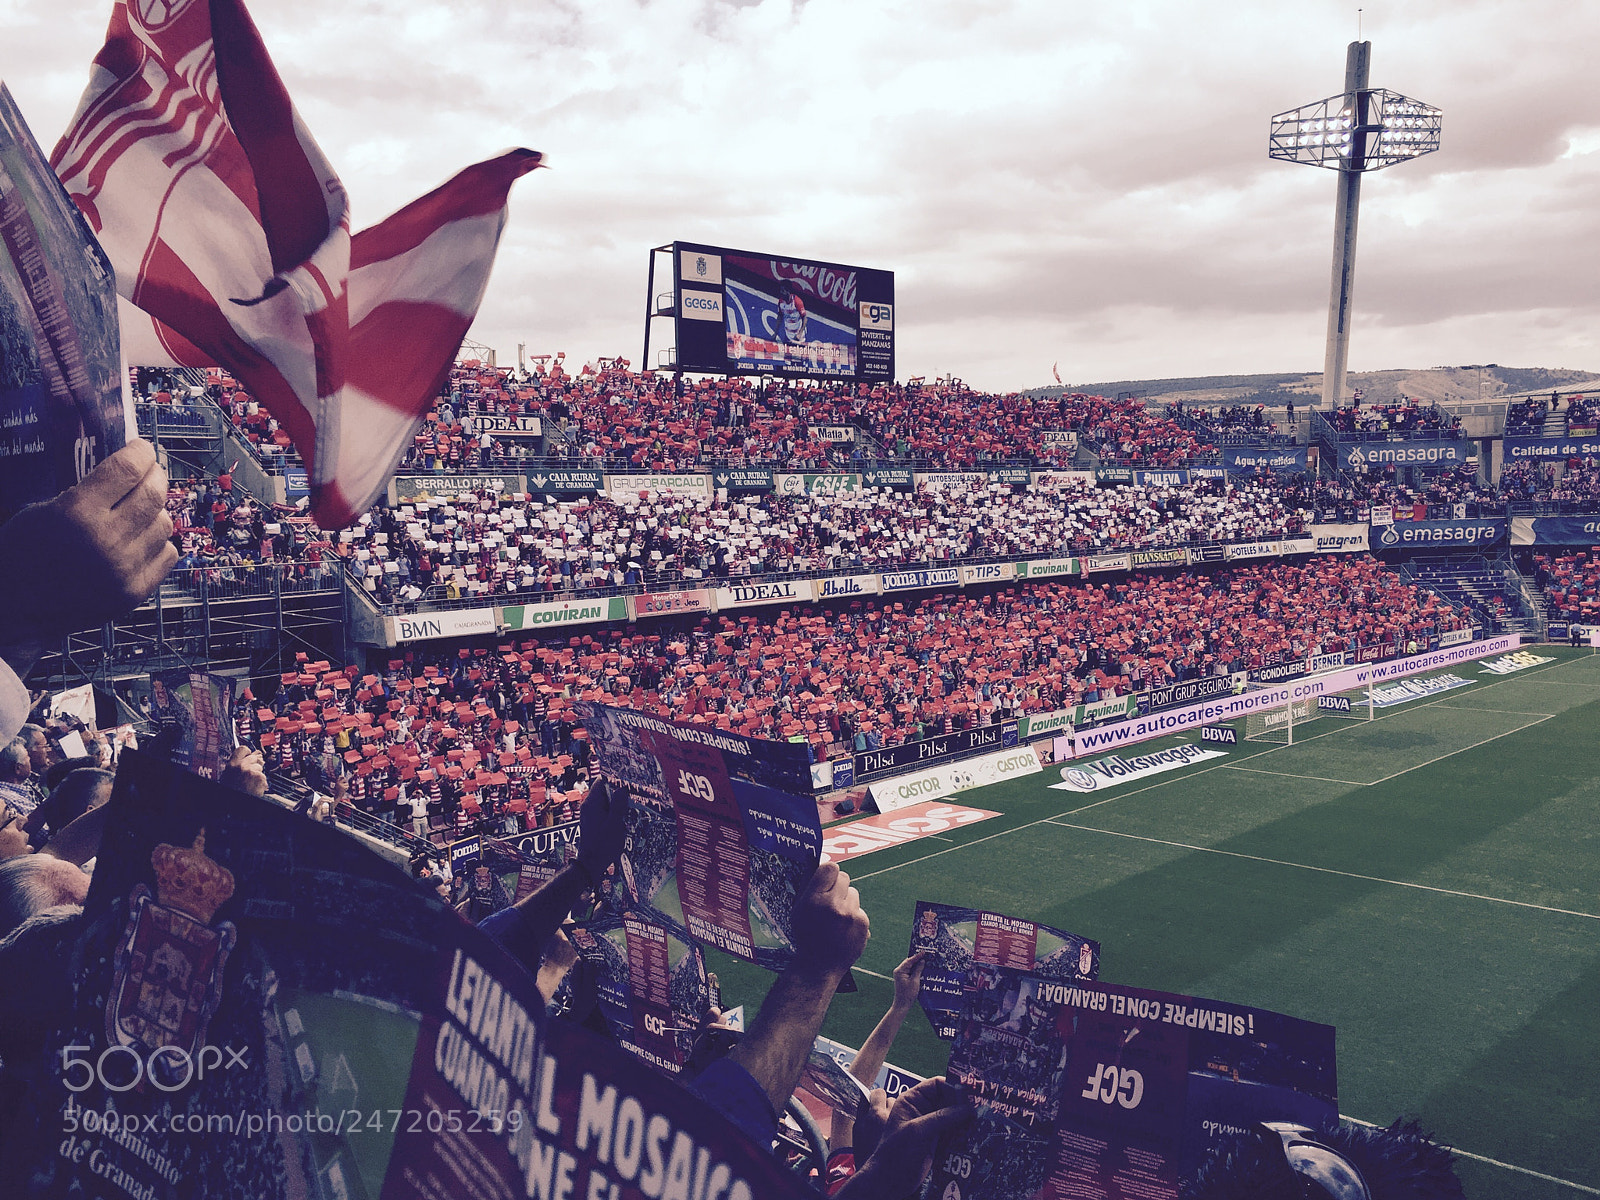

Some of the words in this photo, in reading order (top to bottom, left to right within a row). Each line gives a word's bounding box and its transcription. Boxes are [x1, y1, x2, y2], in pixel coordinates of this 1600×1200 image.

[862, 304, 891, 324] cga
[861, 340, 891, 349] MANZANAS
[1368, 446, 1456, 464] emasagra
[1512, 444, 1558, 456] Calidad
[1562, 445, 1577, 455] de
[415, 479, 470, 489] SERRALLO
[570, 472, 599, 482] RURAL
[747, 471, 770, 480] RURAL
[1403, 525, 1496, 543] emasagra
[1231, 546, 1257, 556] HOTELES
[1032, 562, 1069, 575] COVIRAN
[733, 583, 796, 602] IDEAL
[684, 599, 700, 607] Jeep
[532, 606, 601, 624] COVIRAN
[401, 619, 442, 639] BMN
[1313, 655, 1342, 671] BERNER
[1152, 689, 1174, 706] PONT
[1175, 684, 1197, 701] GRUP
[1199, 676, 1232, 695] SEGUROS
[1292, 707, 1306, 719] YRE
[1318, 697, 1350, 711] BBVA
[1031, 713, 1073, 732] COVIRAN
[1082, 682, 1324, 750] www.autocares-moreno.com
[666, 723, 677, 738] EL
[677, 727, 701, 743] CON
[1202, 727, 1236, 743] BBVA
[997, 754, 1035, 773] CASTOR
[1091, 743, 1207, 778] Volkswagen
[678, 768, 715, 802] GCF
[898, 777, 941, 799] CASTOR
[748, 808, 772, 822] mundo
[775, 816, 787, 831] del
[790, 821, 817, 840] bonita
[775, 832, 801, 849] ciudad
[452, 842, 480, 861] Joma
[803, 842, 817, 858] La
[981, 913, 1004, 924] LEVANTA
[1010, 919, 1034, 931] MOSAICO
[1036, 982, 1107, 1012] GRANADA!
[1111, 993, 1127, 1015] EL
[1127, 996, 1162, 1021] CON
[446, 949, 536, 1097] LEVANTA
[644, 1013, 666, 1037] GCF
[1163, 1001, 1254, 1037] ¡SIEMPRE
[656, 1056, 664, 1068] EL
[960, 1072, 985, 1094] Liga
[990, 1081, 1000, 1096] la
[1002, 1085, 1014, 1099] de
[1082, 1062, 1144, 1110] GCF
[1022, 1108, 1036, 1126] La
[60, 1135, 86, 1164] de
[943, 1153, 972, 1180] GCF
